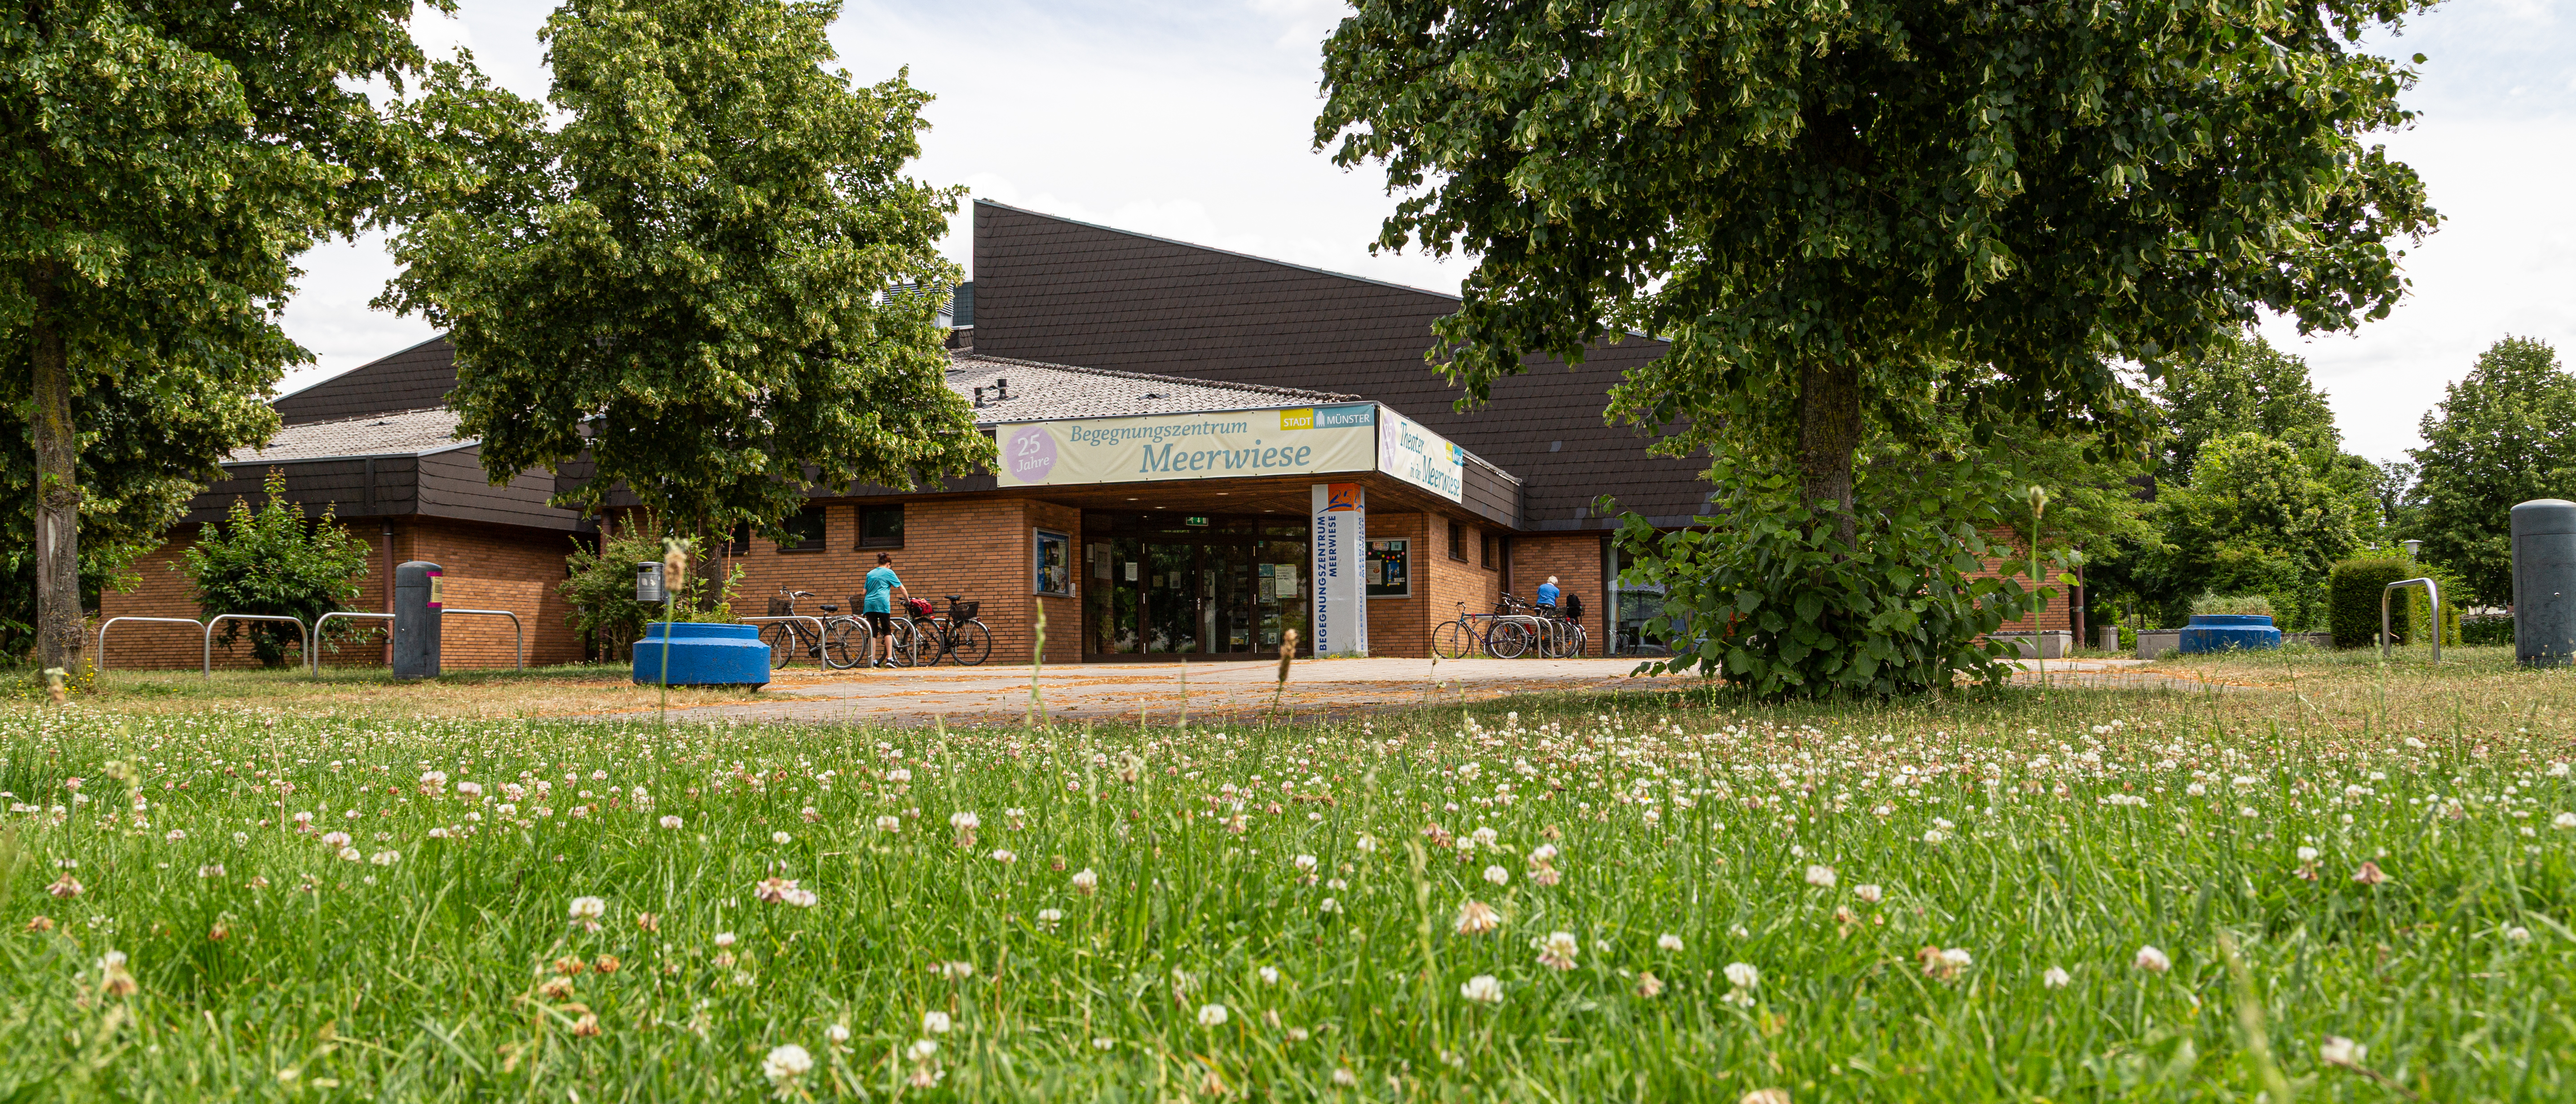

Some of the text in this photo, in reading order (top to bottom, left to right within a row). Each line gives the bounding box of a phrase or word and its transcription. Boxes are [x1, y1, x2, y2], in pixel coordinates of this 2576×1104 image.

[1070, 421, 1247, 446] Begegnungszentrum
[1284, 414, 1370, 427] STADT MÜNSTER
[1018, 434, 1041, 457] 25
[1400, 421, 1424, 455] Theater
[1016, 456, 1050, 472] Jahre
[1139, 439, 1311, 473] Meerwiese
[1410, 462, 1414, 478] in
[1423, 455, 1460, 497] Meerwiese
[1330, 490, 1353, 504] 25
[1328, 516, 1337, 577] MEERWIESE
[1317, 516, 1327, 651] BEGEGNUNGSZENTRUM
